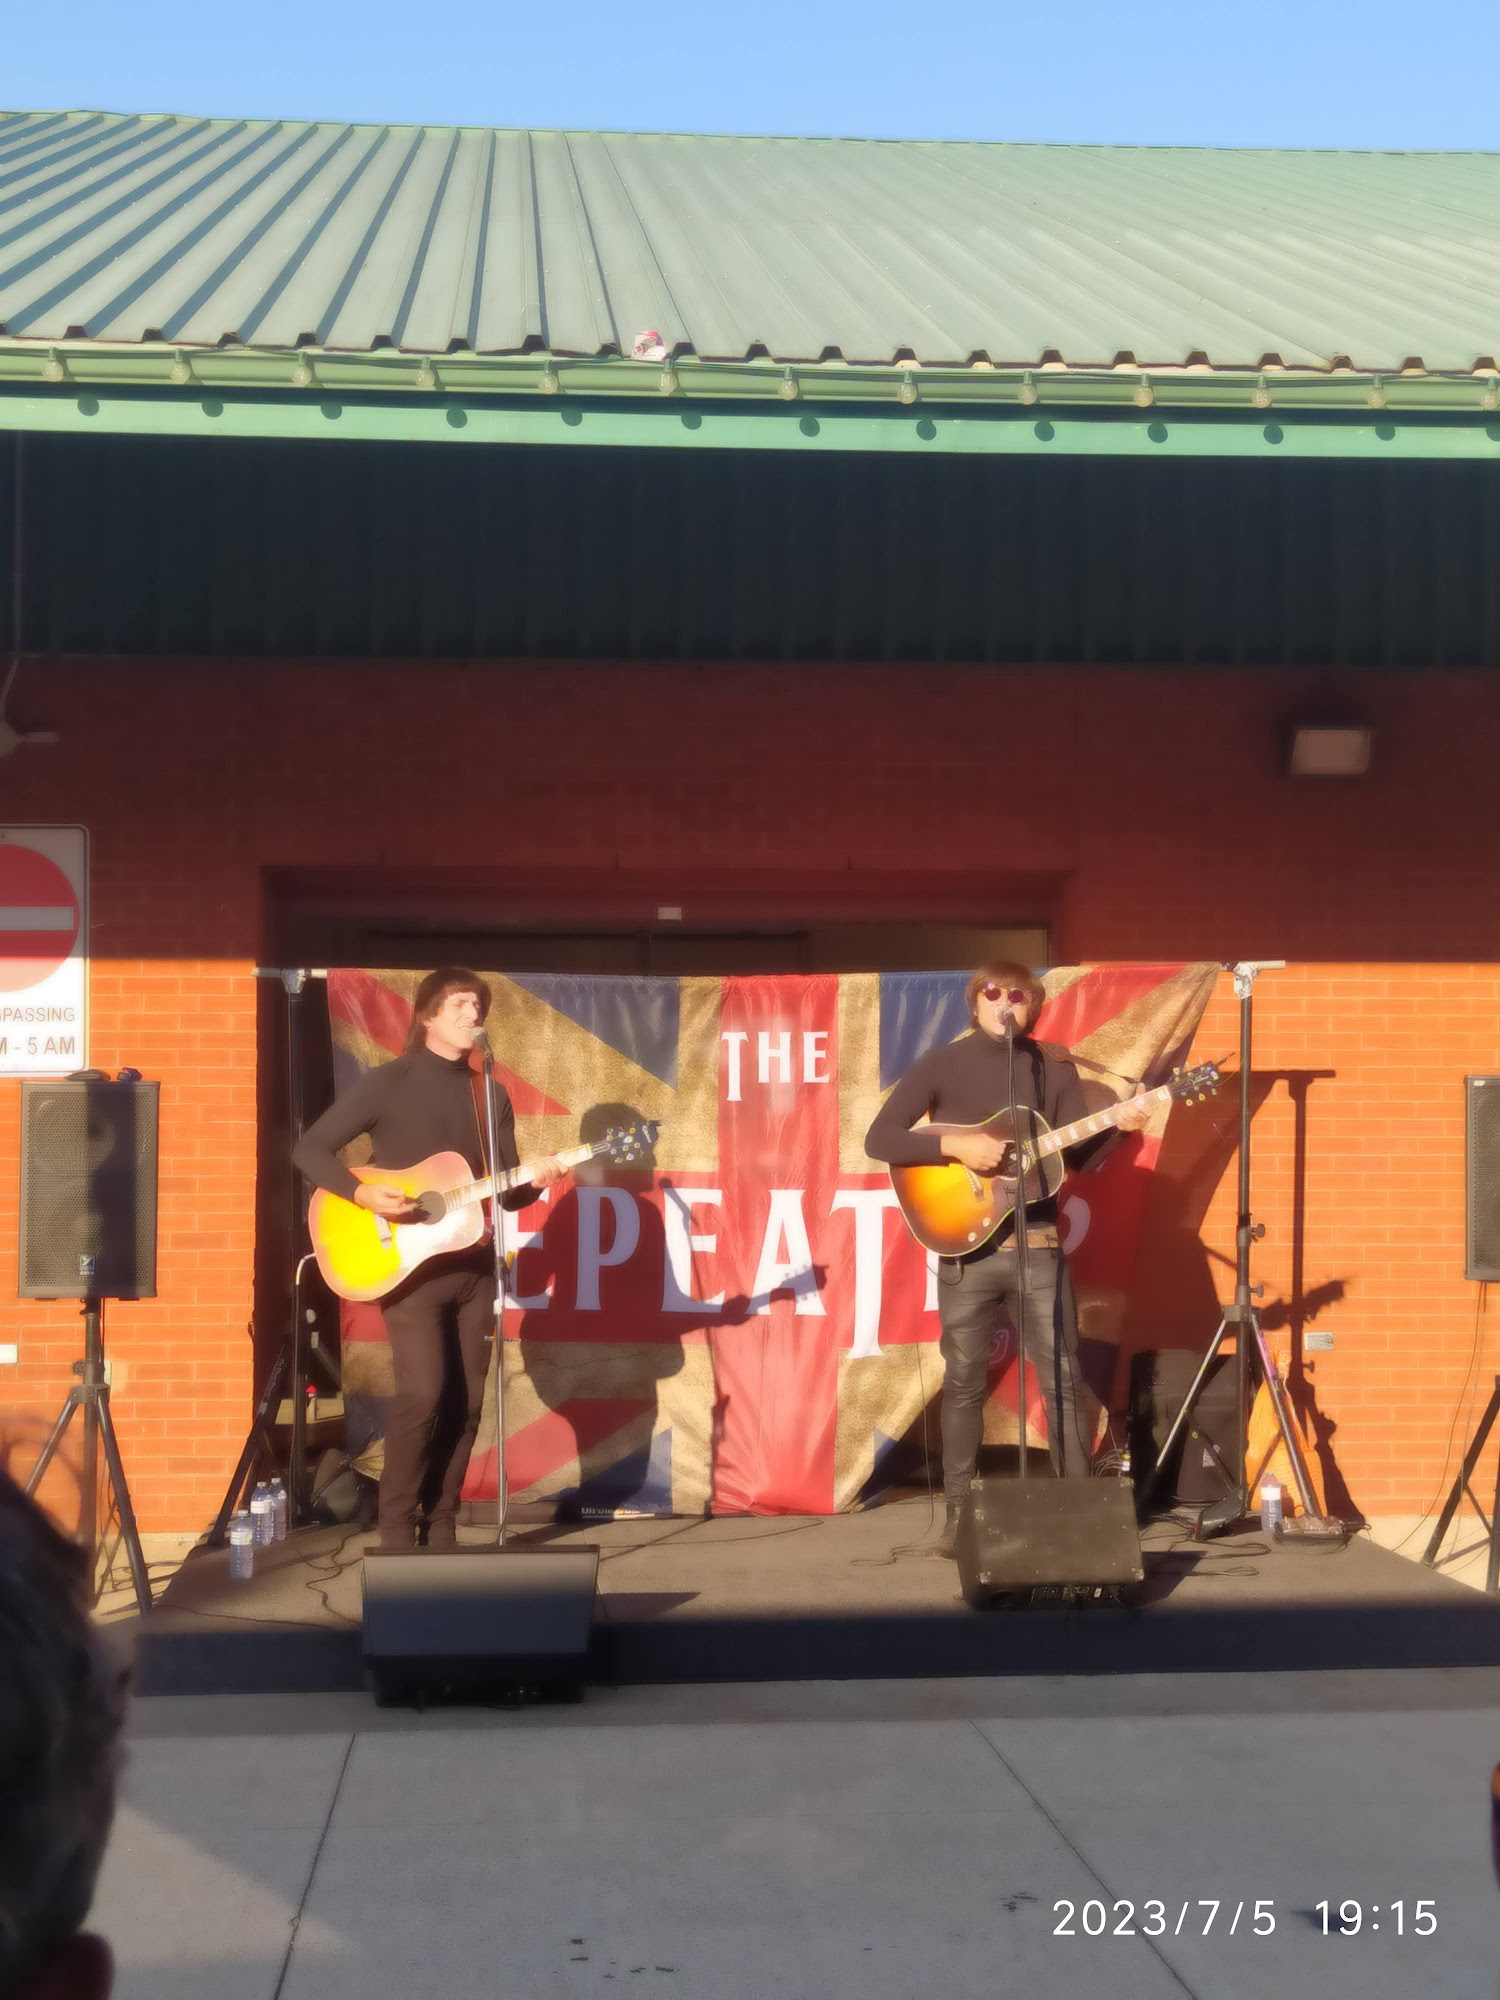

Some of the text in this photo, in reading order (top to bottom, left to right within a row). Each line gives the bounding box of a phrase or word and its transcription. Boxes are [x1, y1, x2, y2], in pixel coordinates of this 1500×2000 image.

[0, 1007, 75, 1022] PASSING
[27, 1036, 38, 1055] 5
[44, 1036, 75, 1055] AM
[720, 1031, 831, 1102] THE
